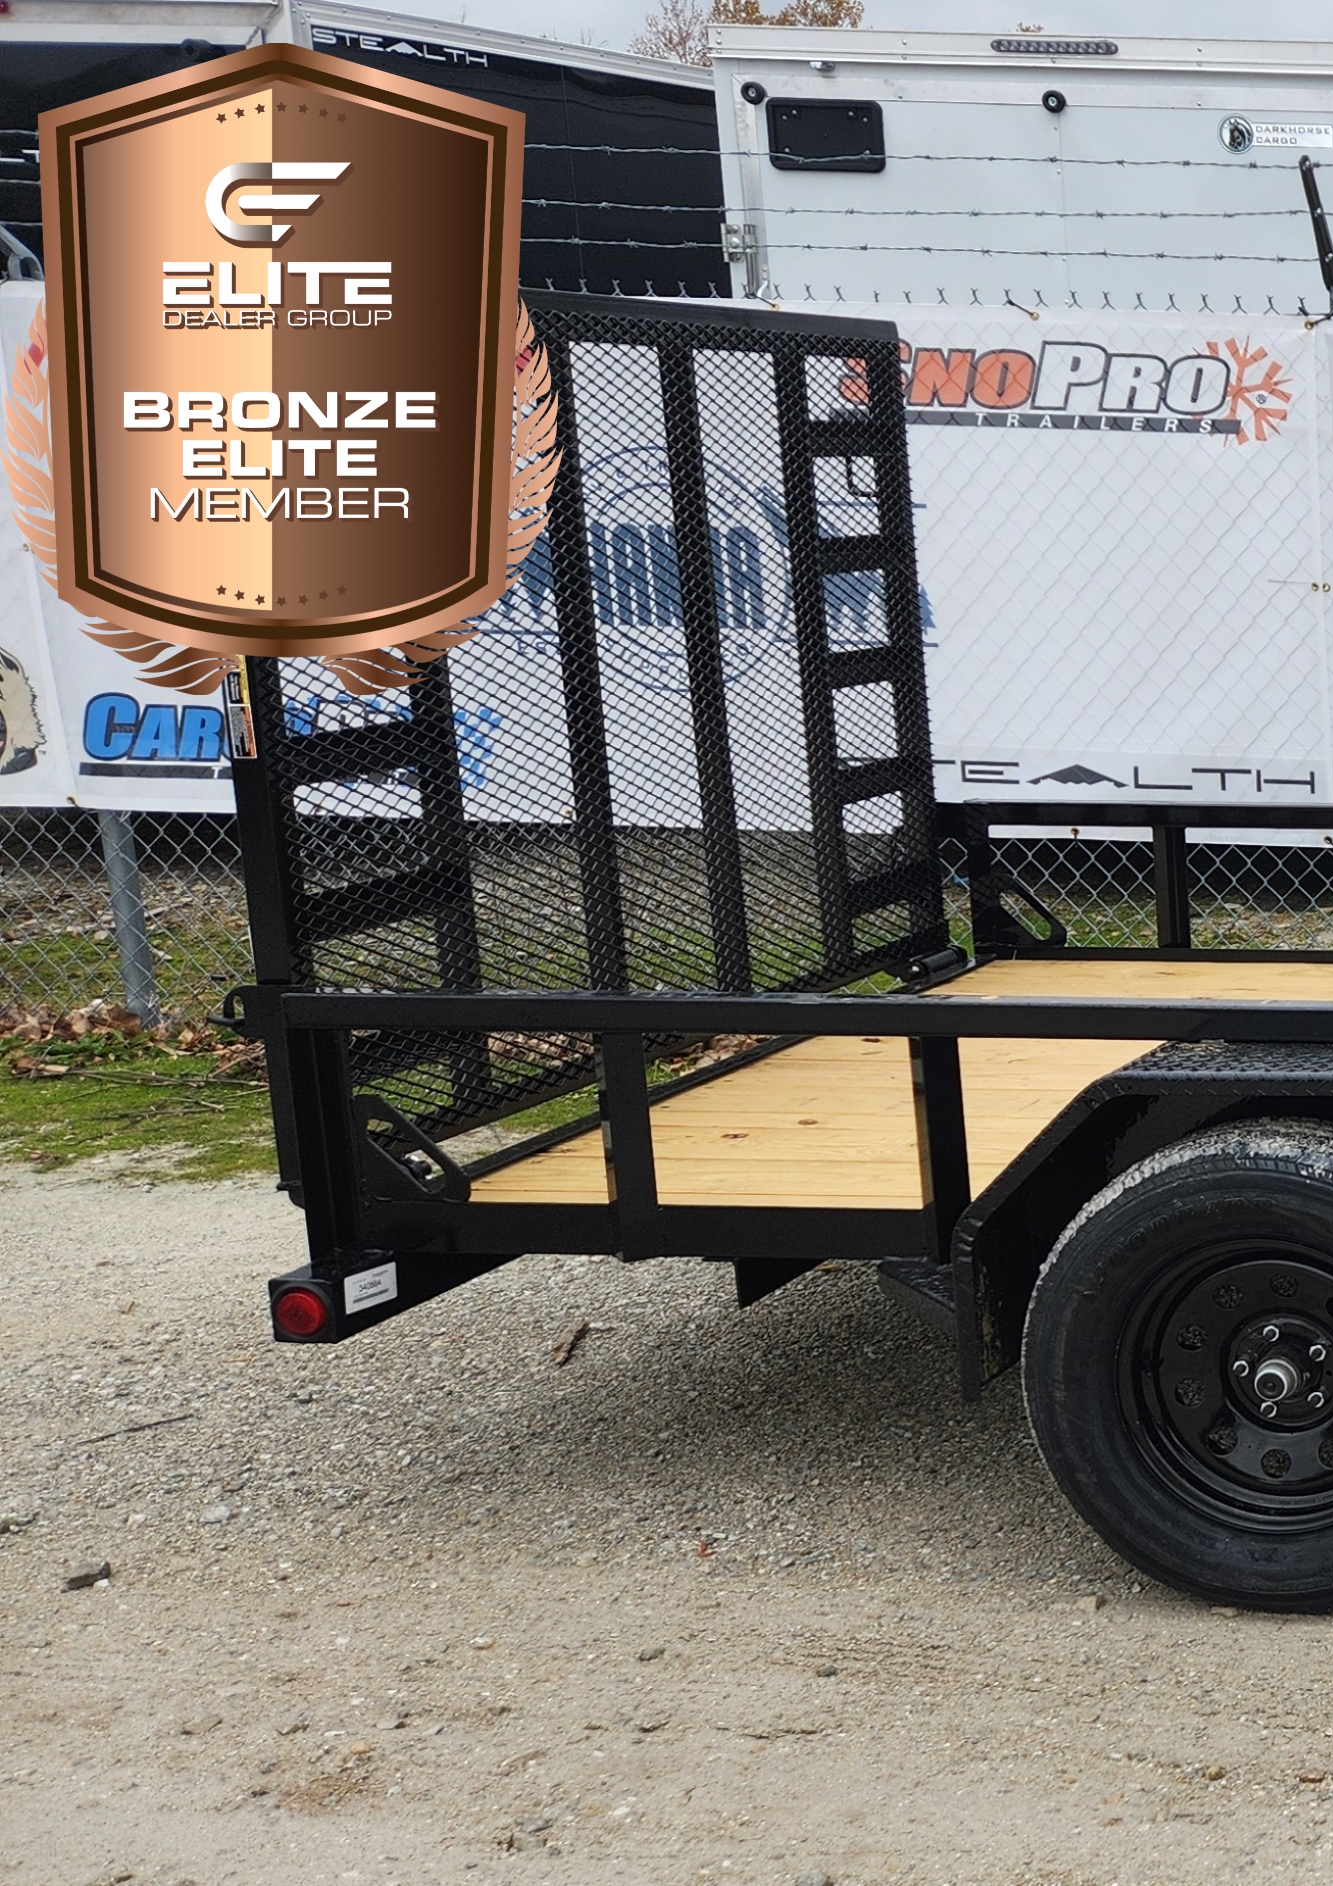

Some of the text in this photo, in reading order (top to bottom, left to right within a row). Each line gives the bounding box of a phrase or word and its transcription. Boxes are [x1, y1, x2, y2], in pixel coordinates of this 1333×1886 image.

[1255, 125, 1331, 135] DARKHORSE
[1256, 136, 1298, 145] CARGO
[974, 411, 1213, 434] TRAILERS
